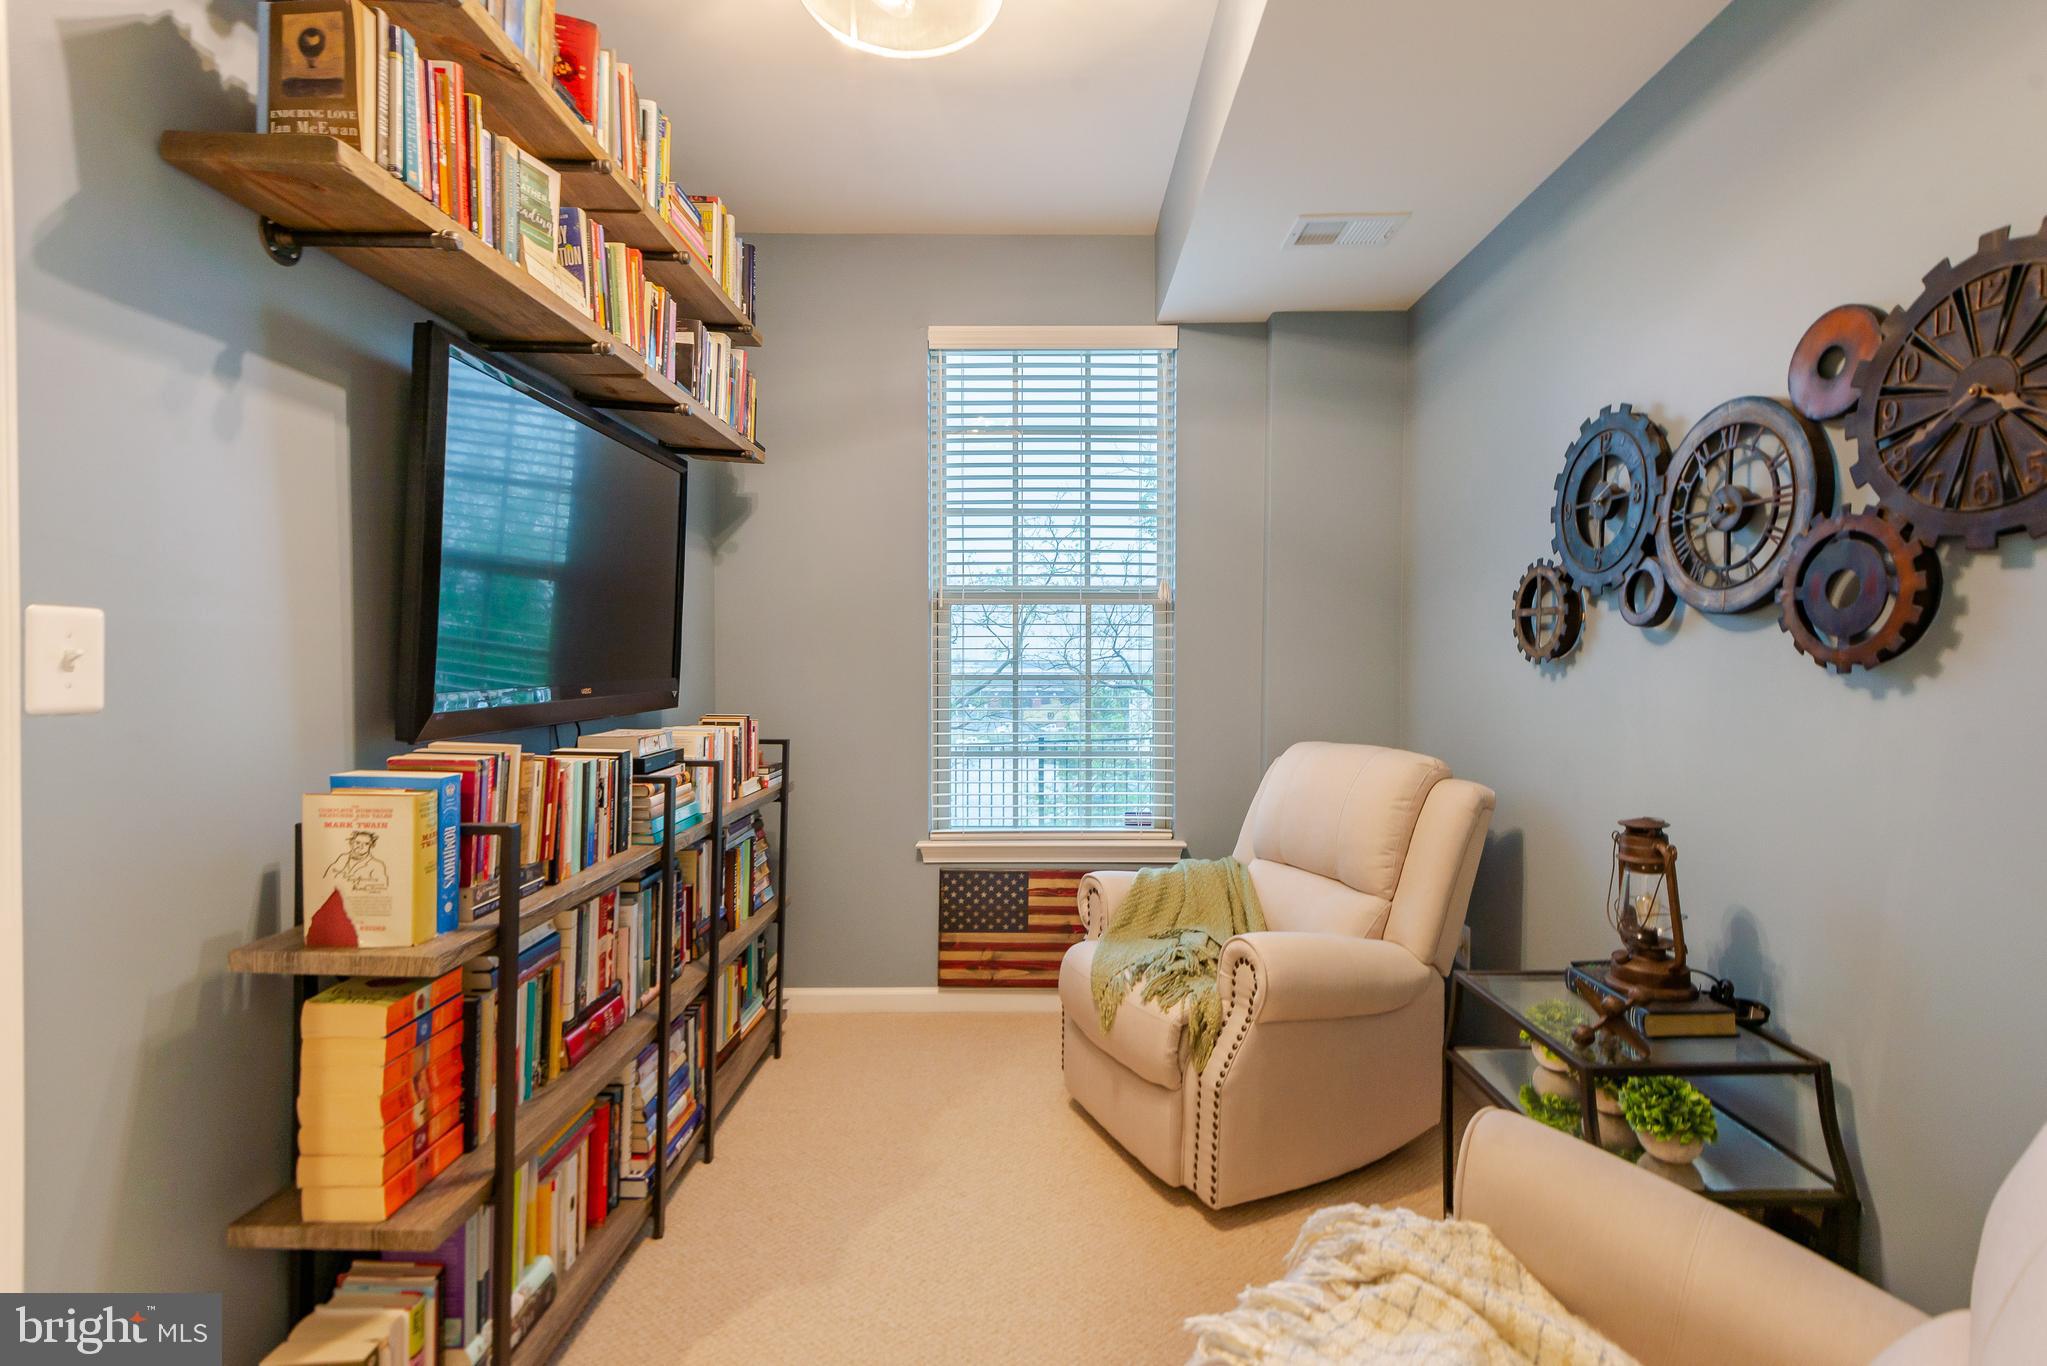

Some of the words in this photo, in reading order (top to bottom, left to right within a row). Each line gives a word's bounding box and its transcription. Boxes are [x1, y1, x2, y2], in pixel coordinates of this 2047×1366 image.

[270, 109, 325, 119] ENDURING
[327, 110, 358, 120] LOVE
[270, 121, 291, 134] Ian
[297, 120, 358, 136] McEwan
[1976, 272, 2007, 313] 12
[1933, 303, 1955, 339] 11
[1896, 351, 1921, 385] 10
[1882, 400, 1900, 431] 9
[1719, 423, 1741, 451] XII
[2025, 450, 2047, 485] 5
[1633, 482, 1642, 505] 3
[1922, 471, 1943, 505] 7
[1974, 471, 1995, 505] 6
[324, 821, 353, 829] MARK
